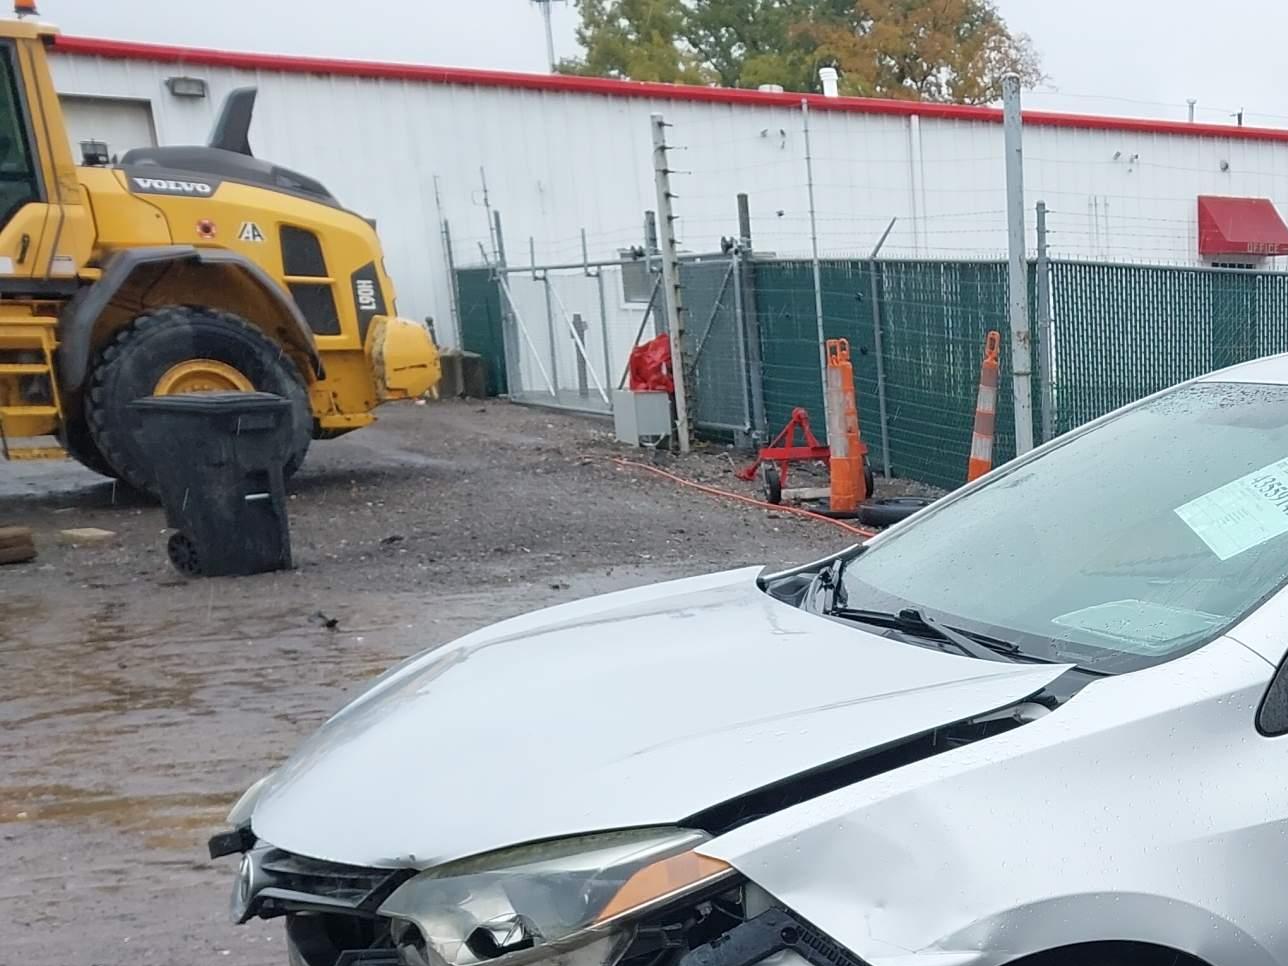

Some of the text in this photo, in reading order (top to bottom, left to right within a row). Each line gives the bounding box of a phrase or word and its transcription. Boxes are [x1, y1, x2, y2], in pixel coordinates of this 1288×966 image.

[132, 177, 212, 193] VOLVO
[1247, 242, 1280, 253] OFFICE
[356, 279, 377, 310] L90H
